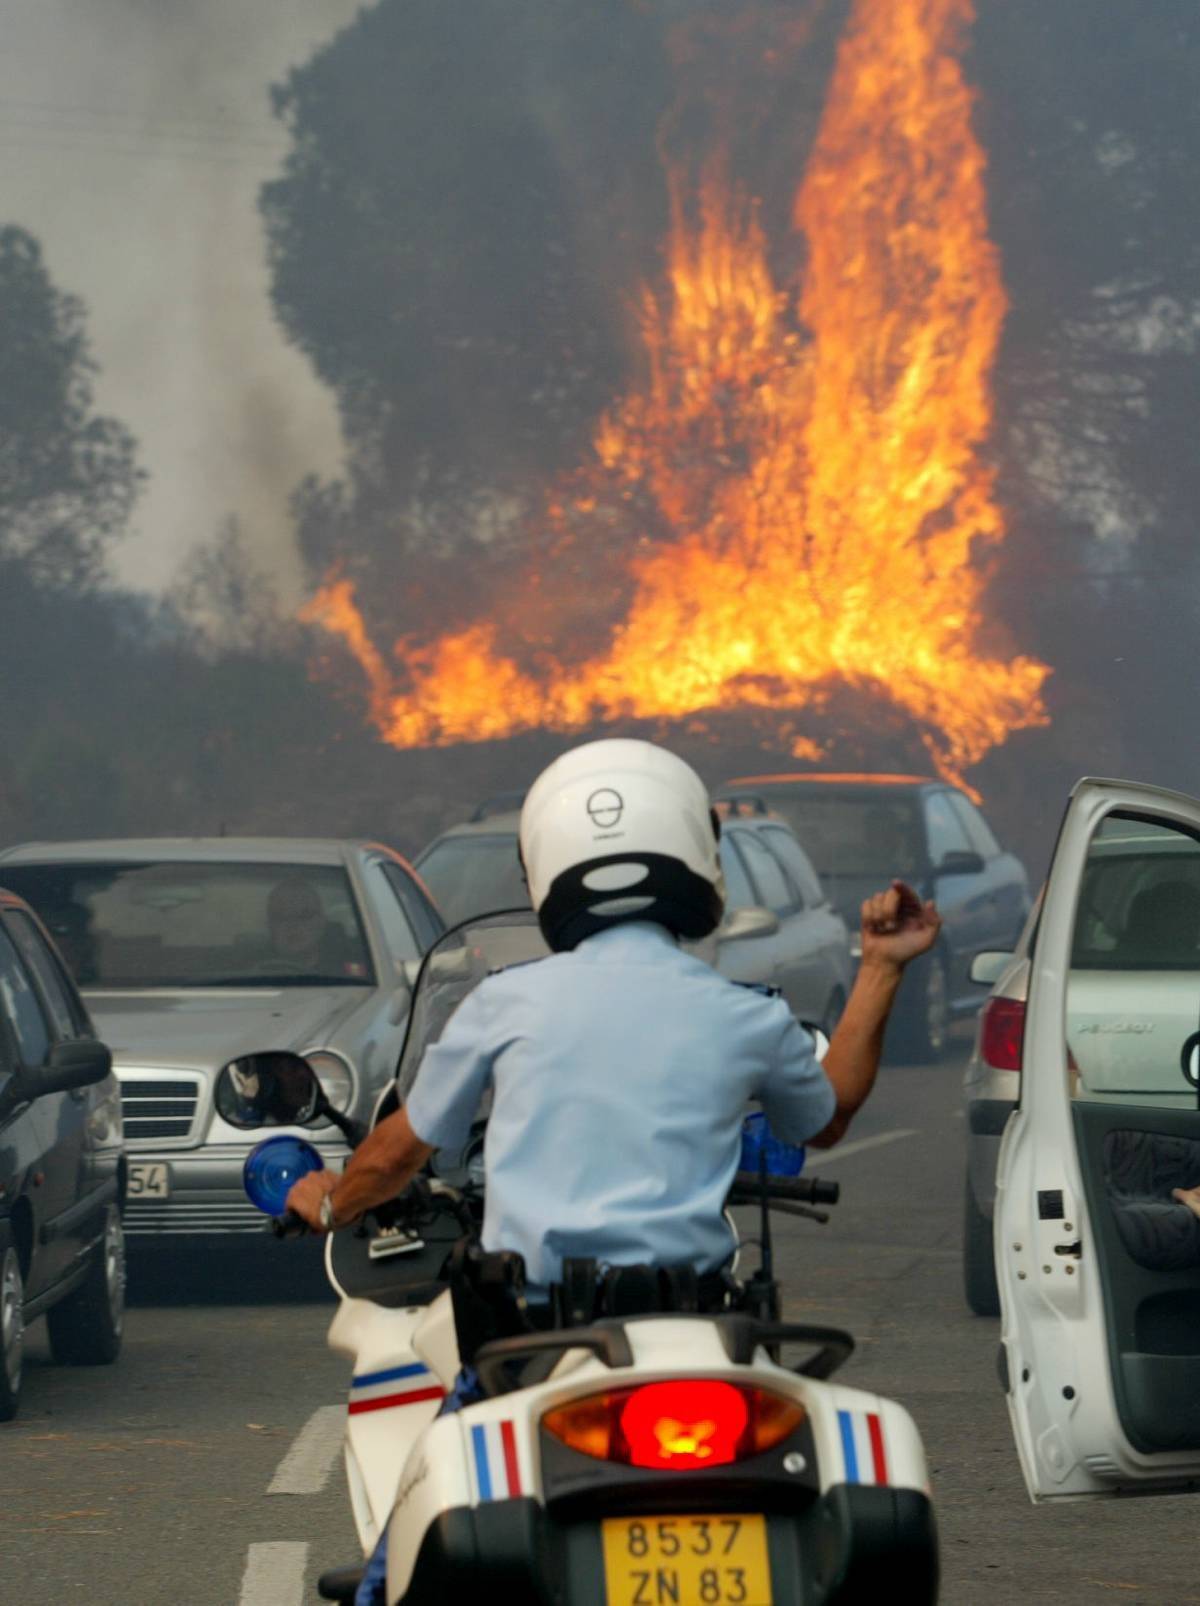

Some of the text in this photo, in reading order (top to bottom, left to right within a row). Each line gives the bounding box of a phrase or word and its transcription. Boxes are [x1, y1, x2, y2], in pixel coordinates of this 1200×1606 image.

[128, 1167, 161, 1194] 54
[627, 1519, 742, 1557] 8537
[629, 1567, 748, 1605] ZN 83
